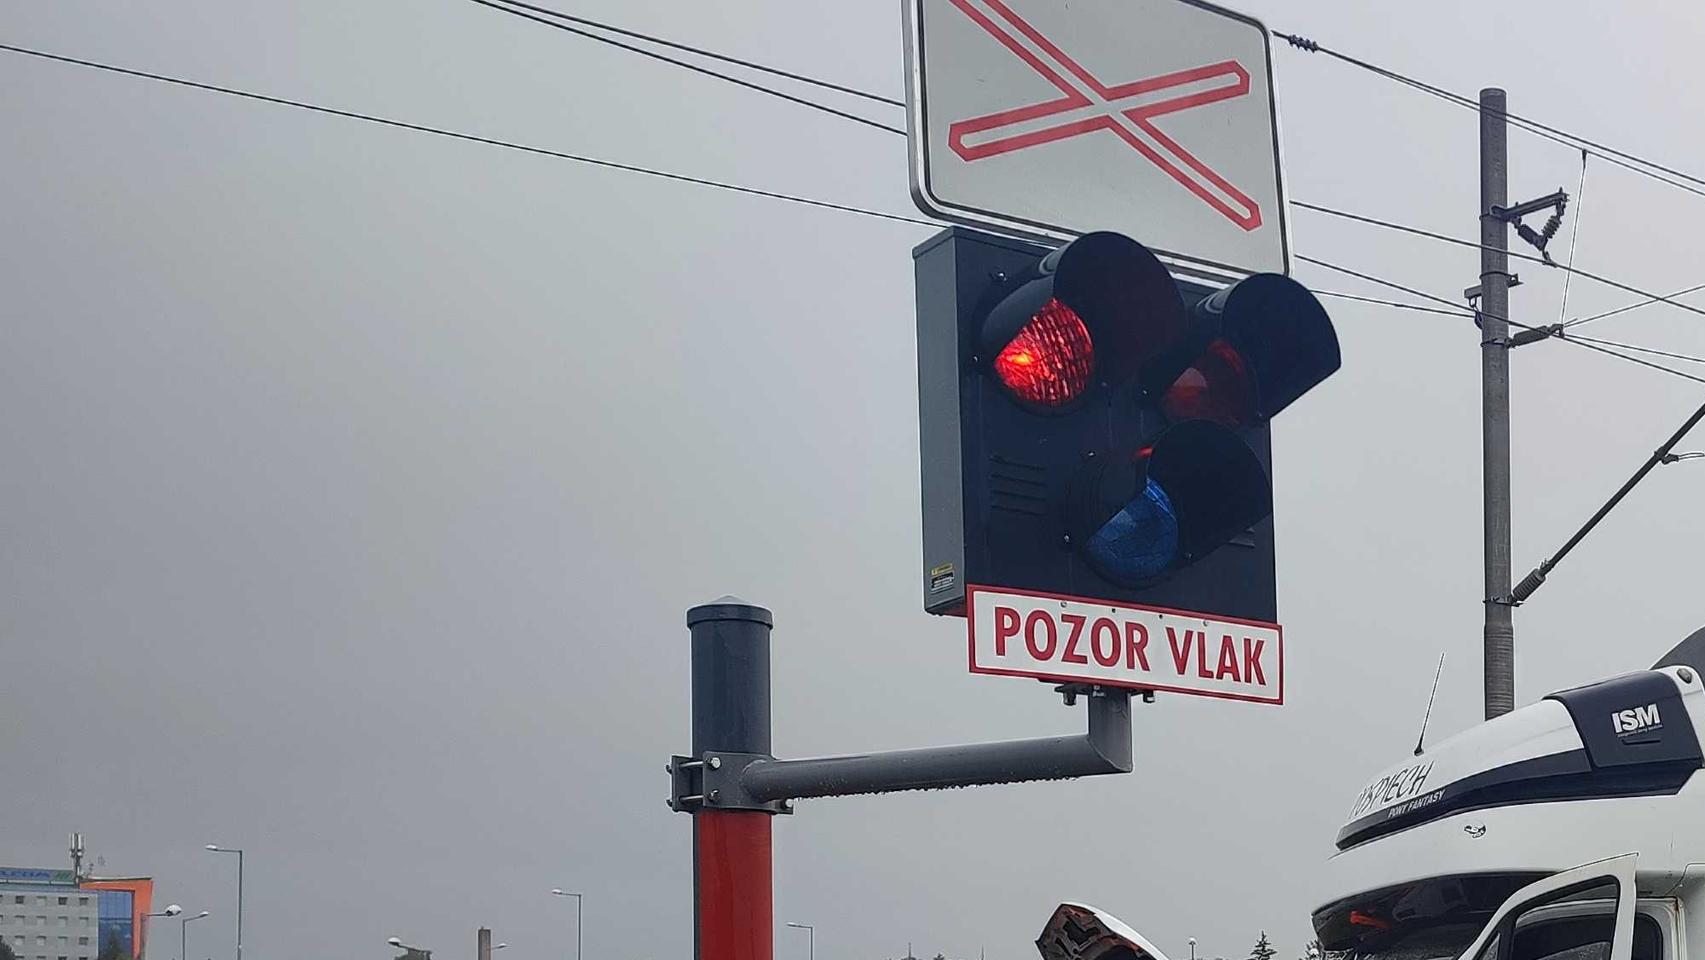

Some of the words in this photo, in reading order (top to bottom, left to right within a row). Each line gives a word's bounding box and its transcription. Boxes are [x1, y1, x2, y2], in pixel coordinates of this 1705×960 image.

[994, 606, 1150, 672] POZOR
[1165, 626, 1266, 686] VLAK
[1611, 703, 1661, 733] ISM
